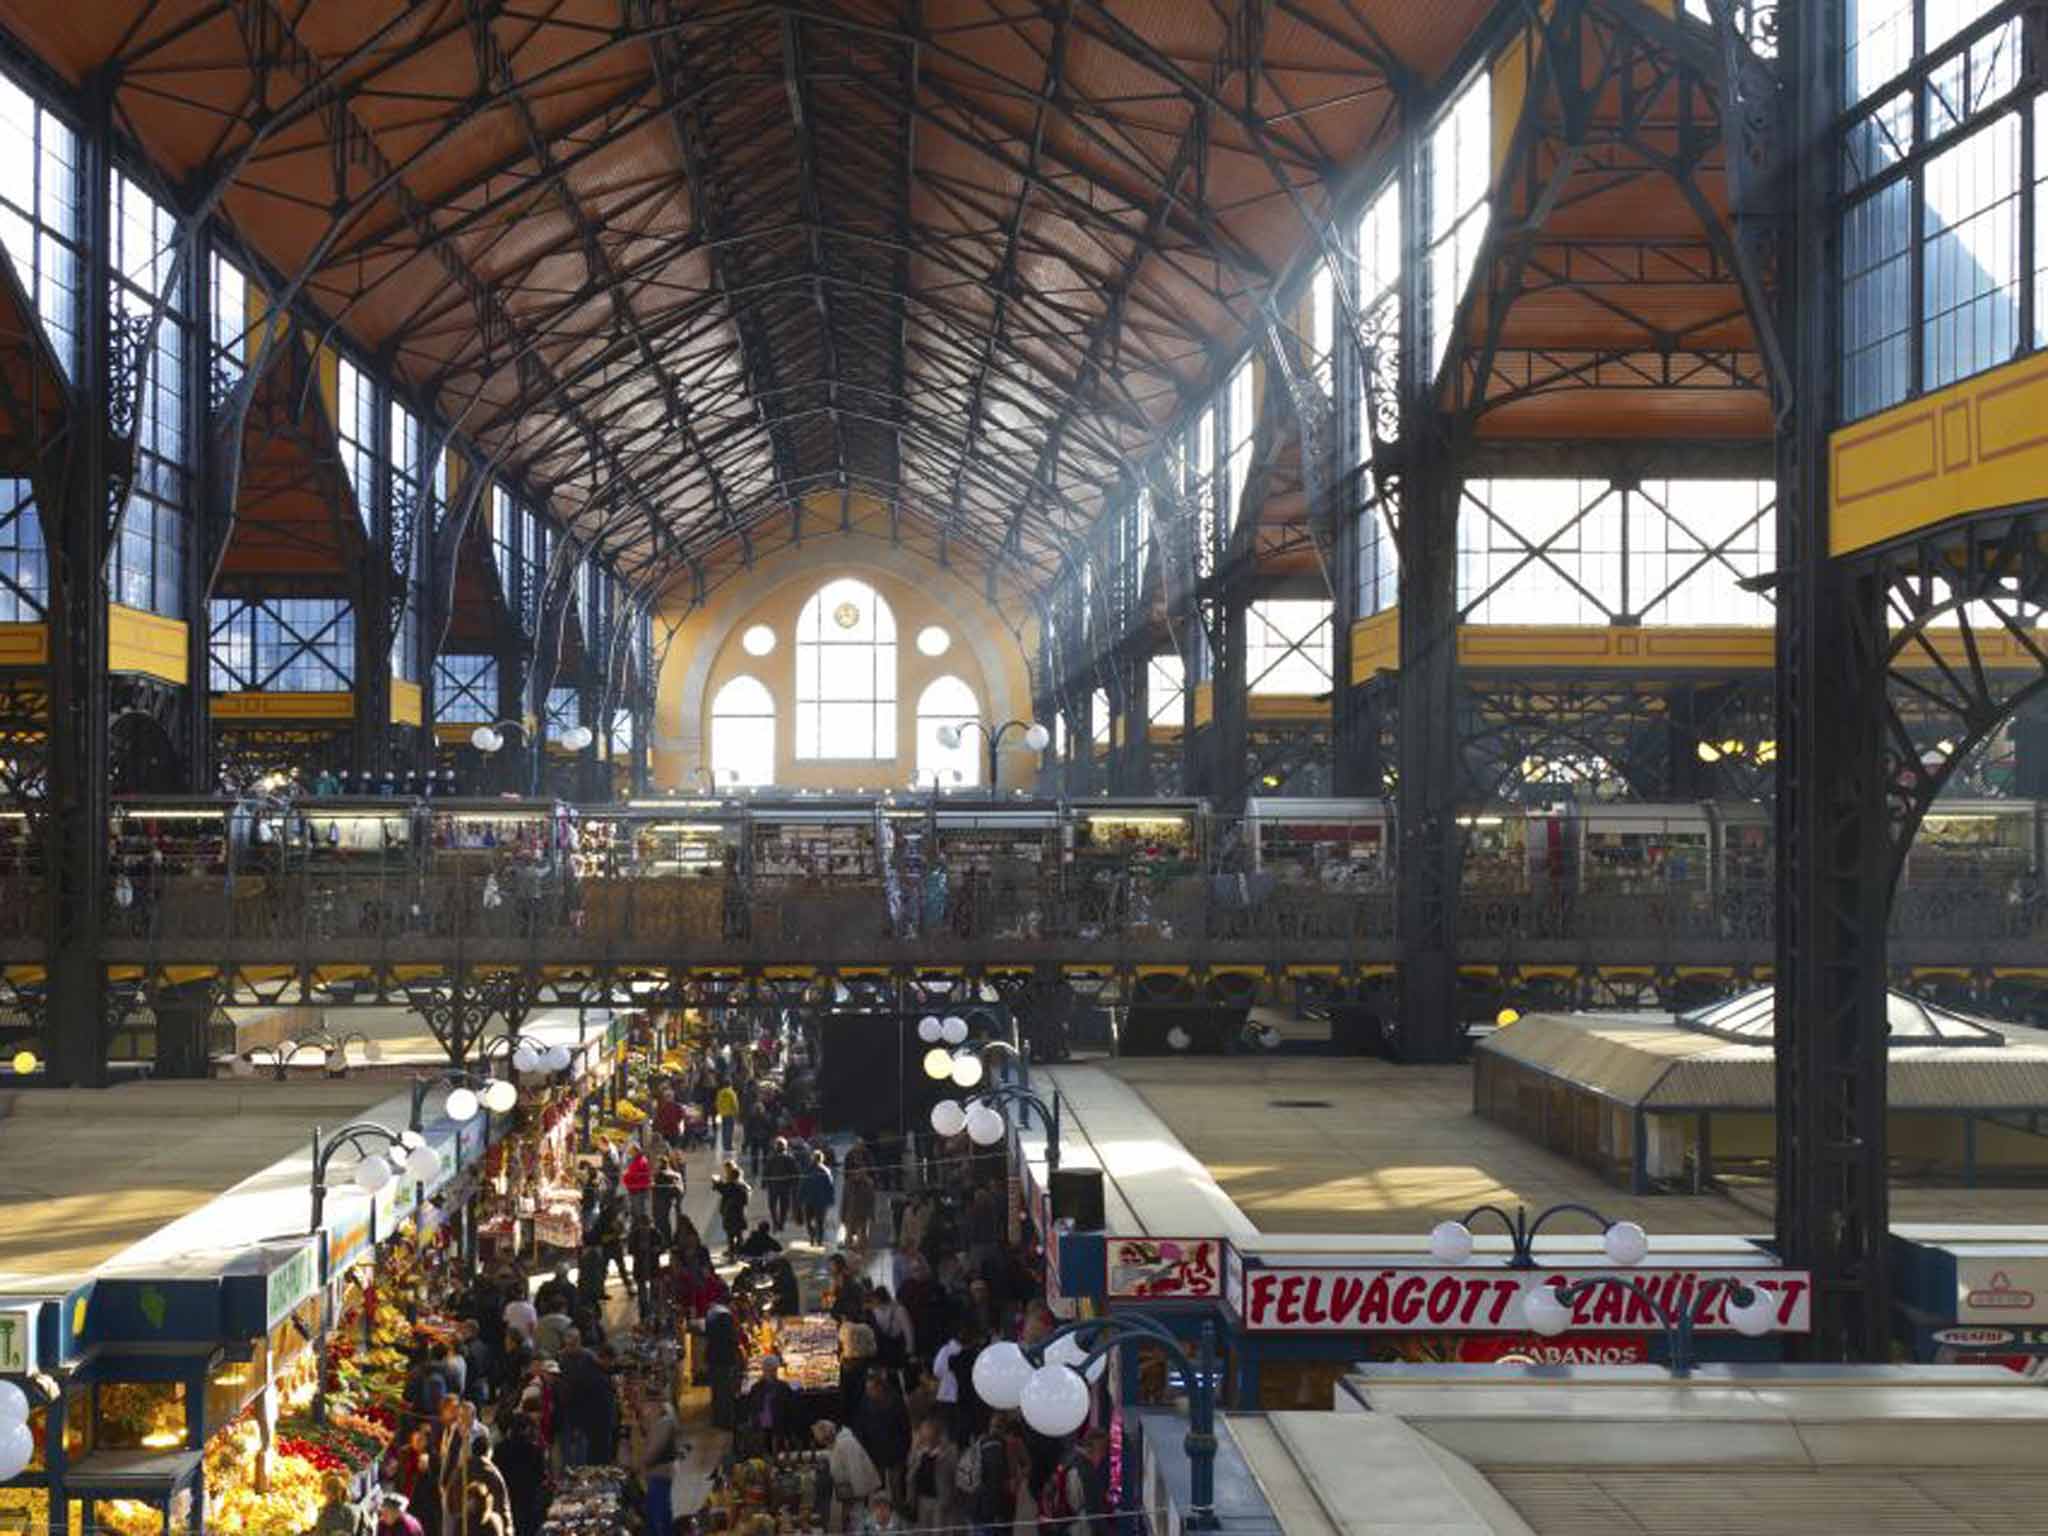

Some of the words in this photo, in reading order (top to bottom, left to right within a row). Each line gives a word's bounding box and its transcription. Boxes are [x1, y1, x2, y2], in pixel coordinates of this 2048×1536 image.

[1251, 1269, 1520, 1325] FELVÁGOTT
[1544, 1273, 1807, 1325] ZAKÜZT
[1508, 1346, 1638, 1364] ABANOS
